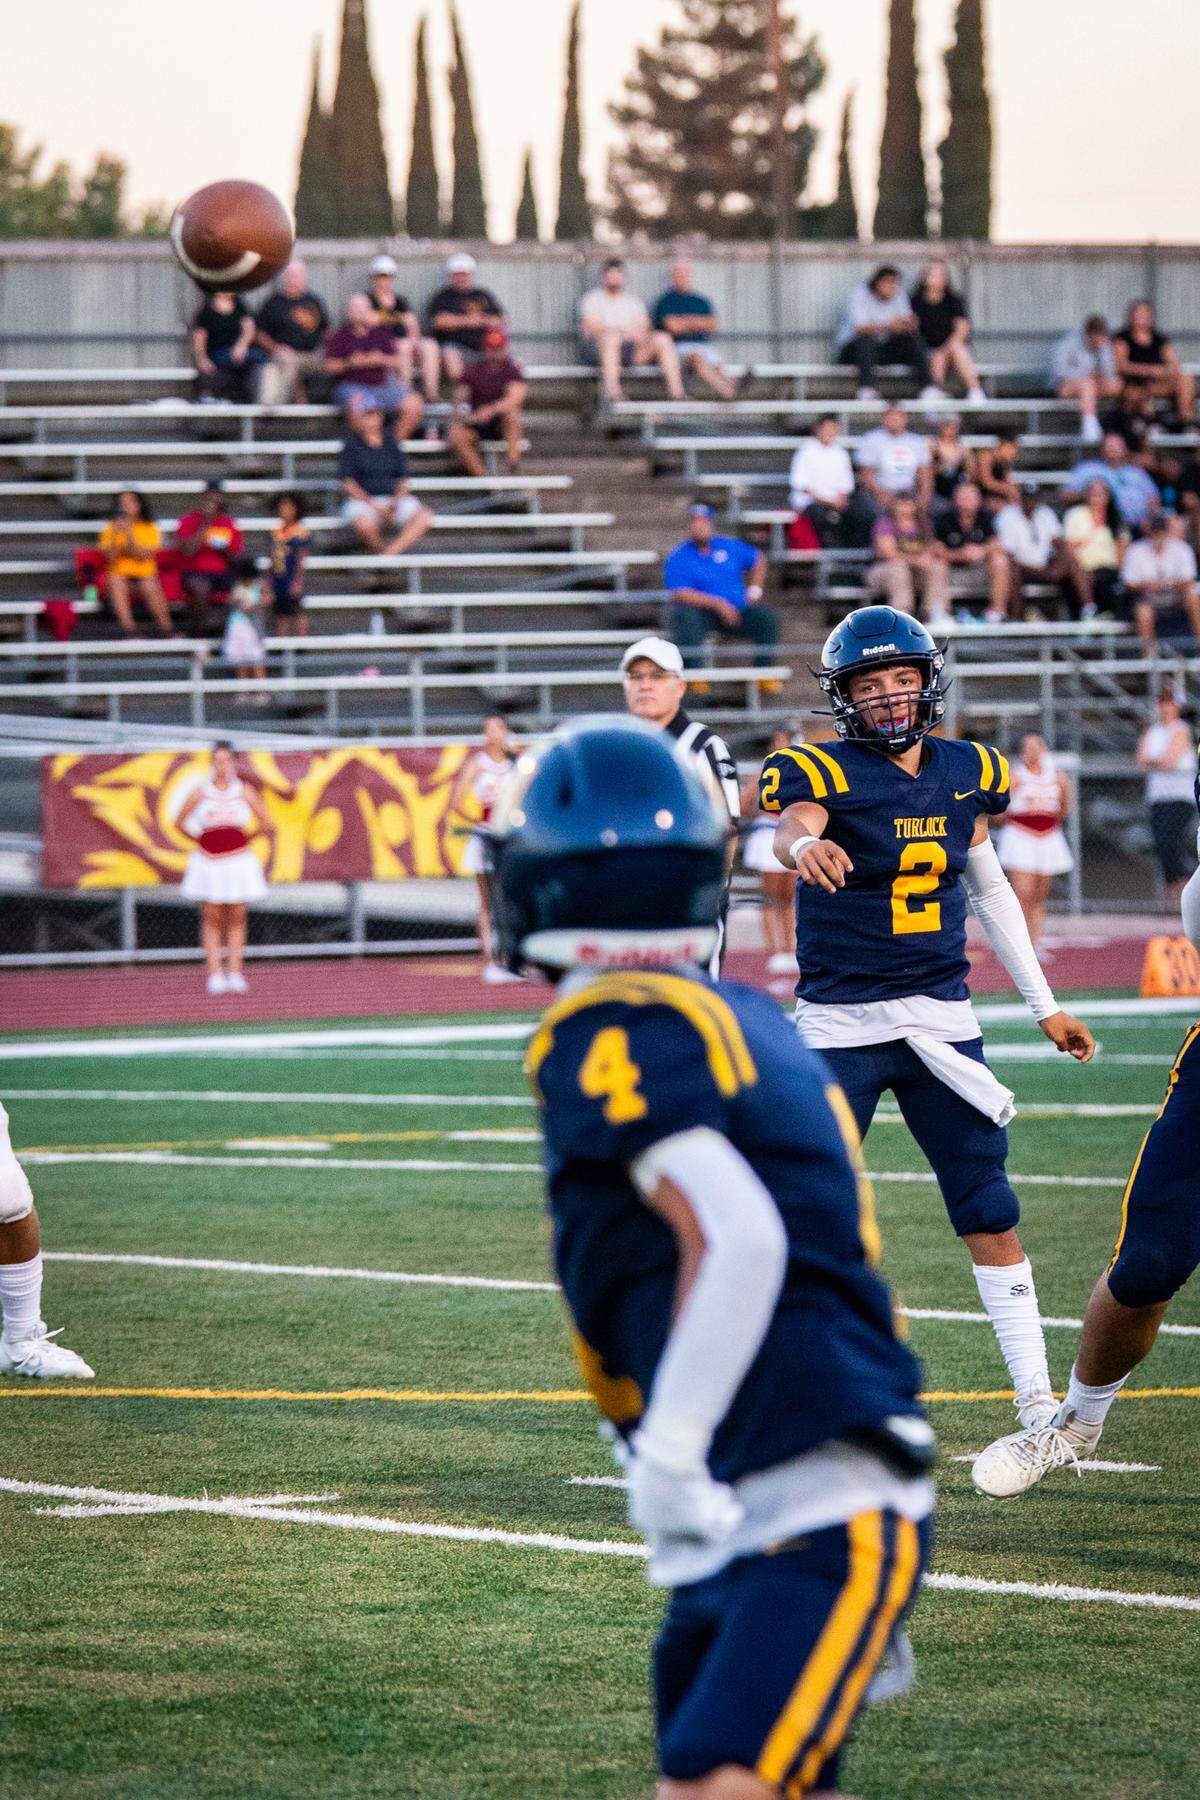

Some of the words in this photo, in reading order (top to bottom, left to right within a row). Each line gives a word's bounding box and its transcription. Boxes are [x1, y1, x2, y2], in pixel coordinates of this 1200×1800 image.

[862, 643, 896, 656] Riddell
[762, 767, 781, 811] 2
[893, 816, 948, 838] TURLOCK
[891, 841, 947, 935] 2
[578, 1026, 647, 1125] 4
